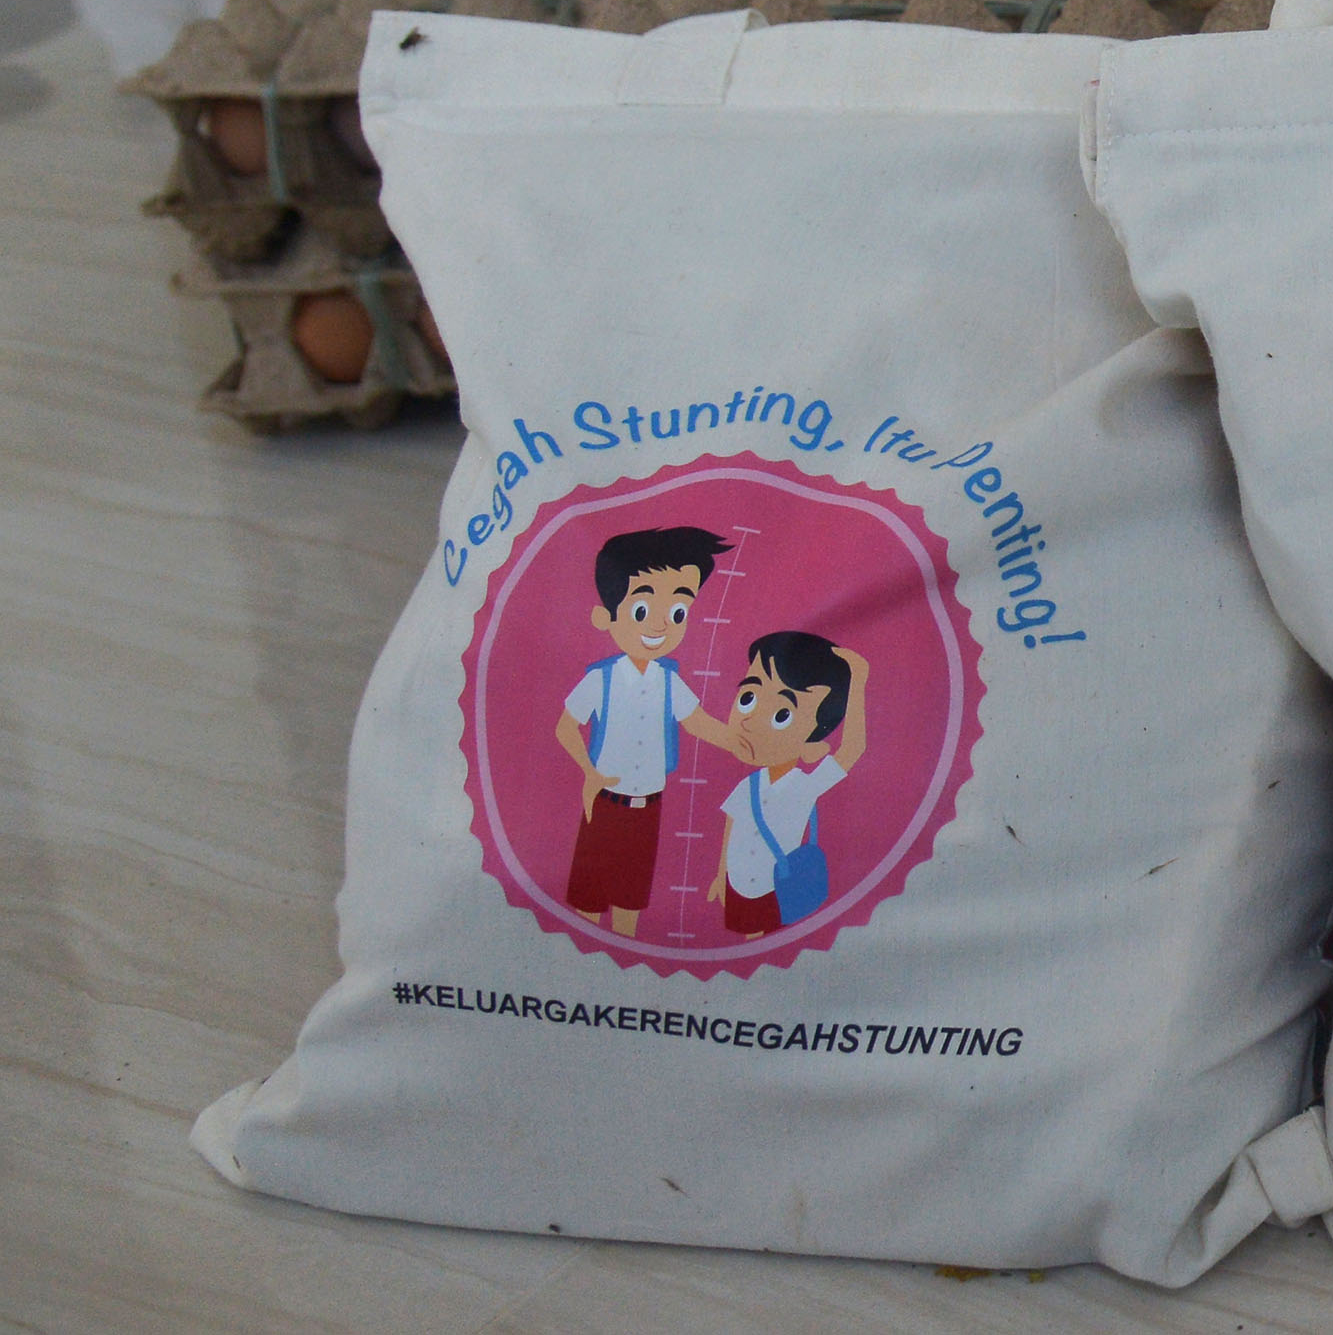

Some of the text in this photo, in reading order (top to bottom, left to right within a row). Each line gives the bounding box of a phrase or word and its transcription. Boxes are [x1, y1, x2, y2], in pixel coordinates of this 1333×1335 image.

[443, 386, 1088, 650] Cegah Stunting, Itu Penting!
[391, 980, 1026, 1059] #KELUARGAKERENCEGAHSTUNTING
